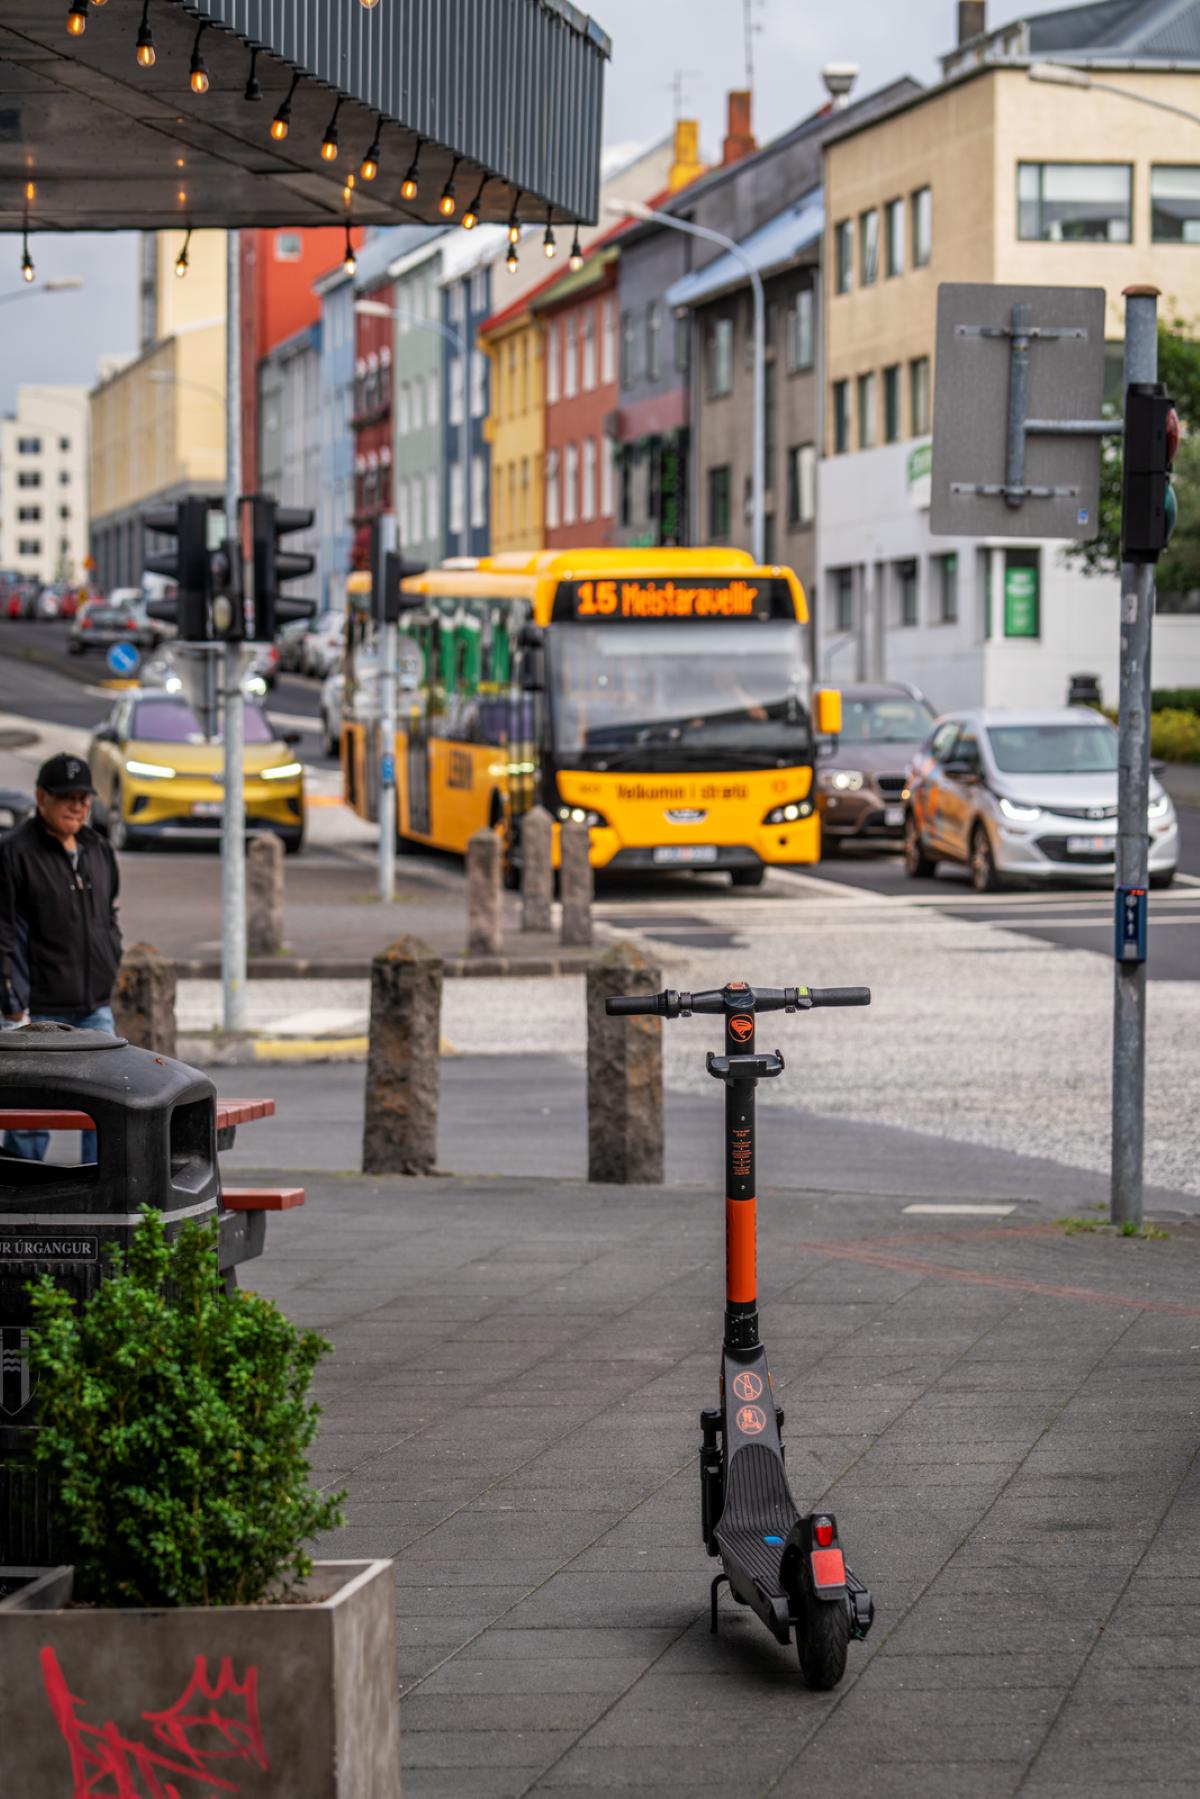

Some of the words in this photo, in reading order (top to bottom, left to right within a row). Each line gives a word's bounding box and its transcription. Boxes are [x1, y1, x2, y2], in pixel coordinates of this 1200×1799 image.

[577, 581, 617, 614] 15
[621, 581, 758, 616] Meistaravellir
[15, 1239, 91, 1254] ÚRGANGUR
